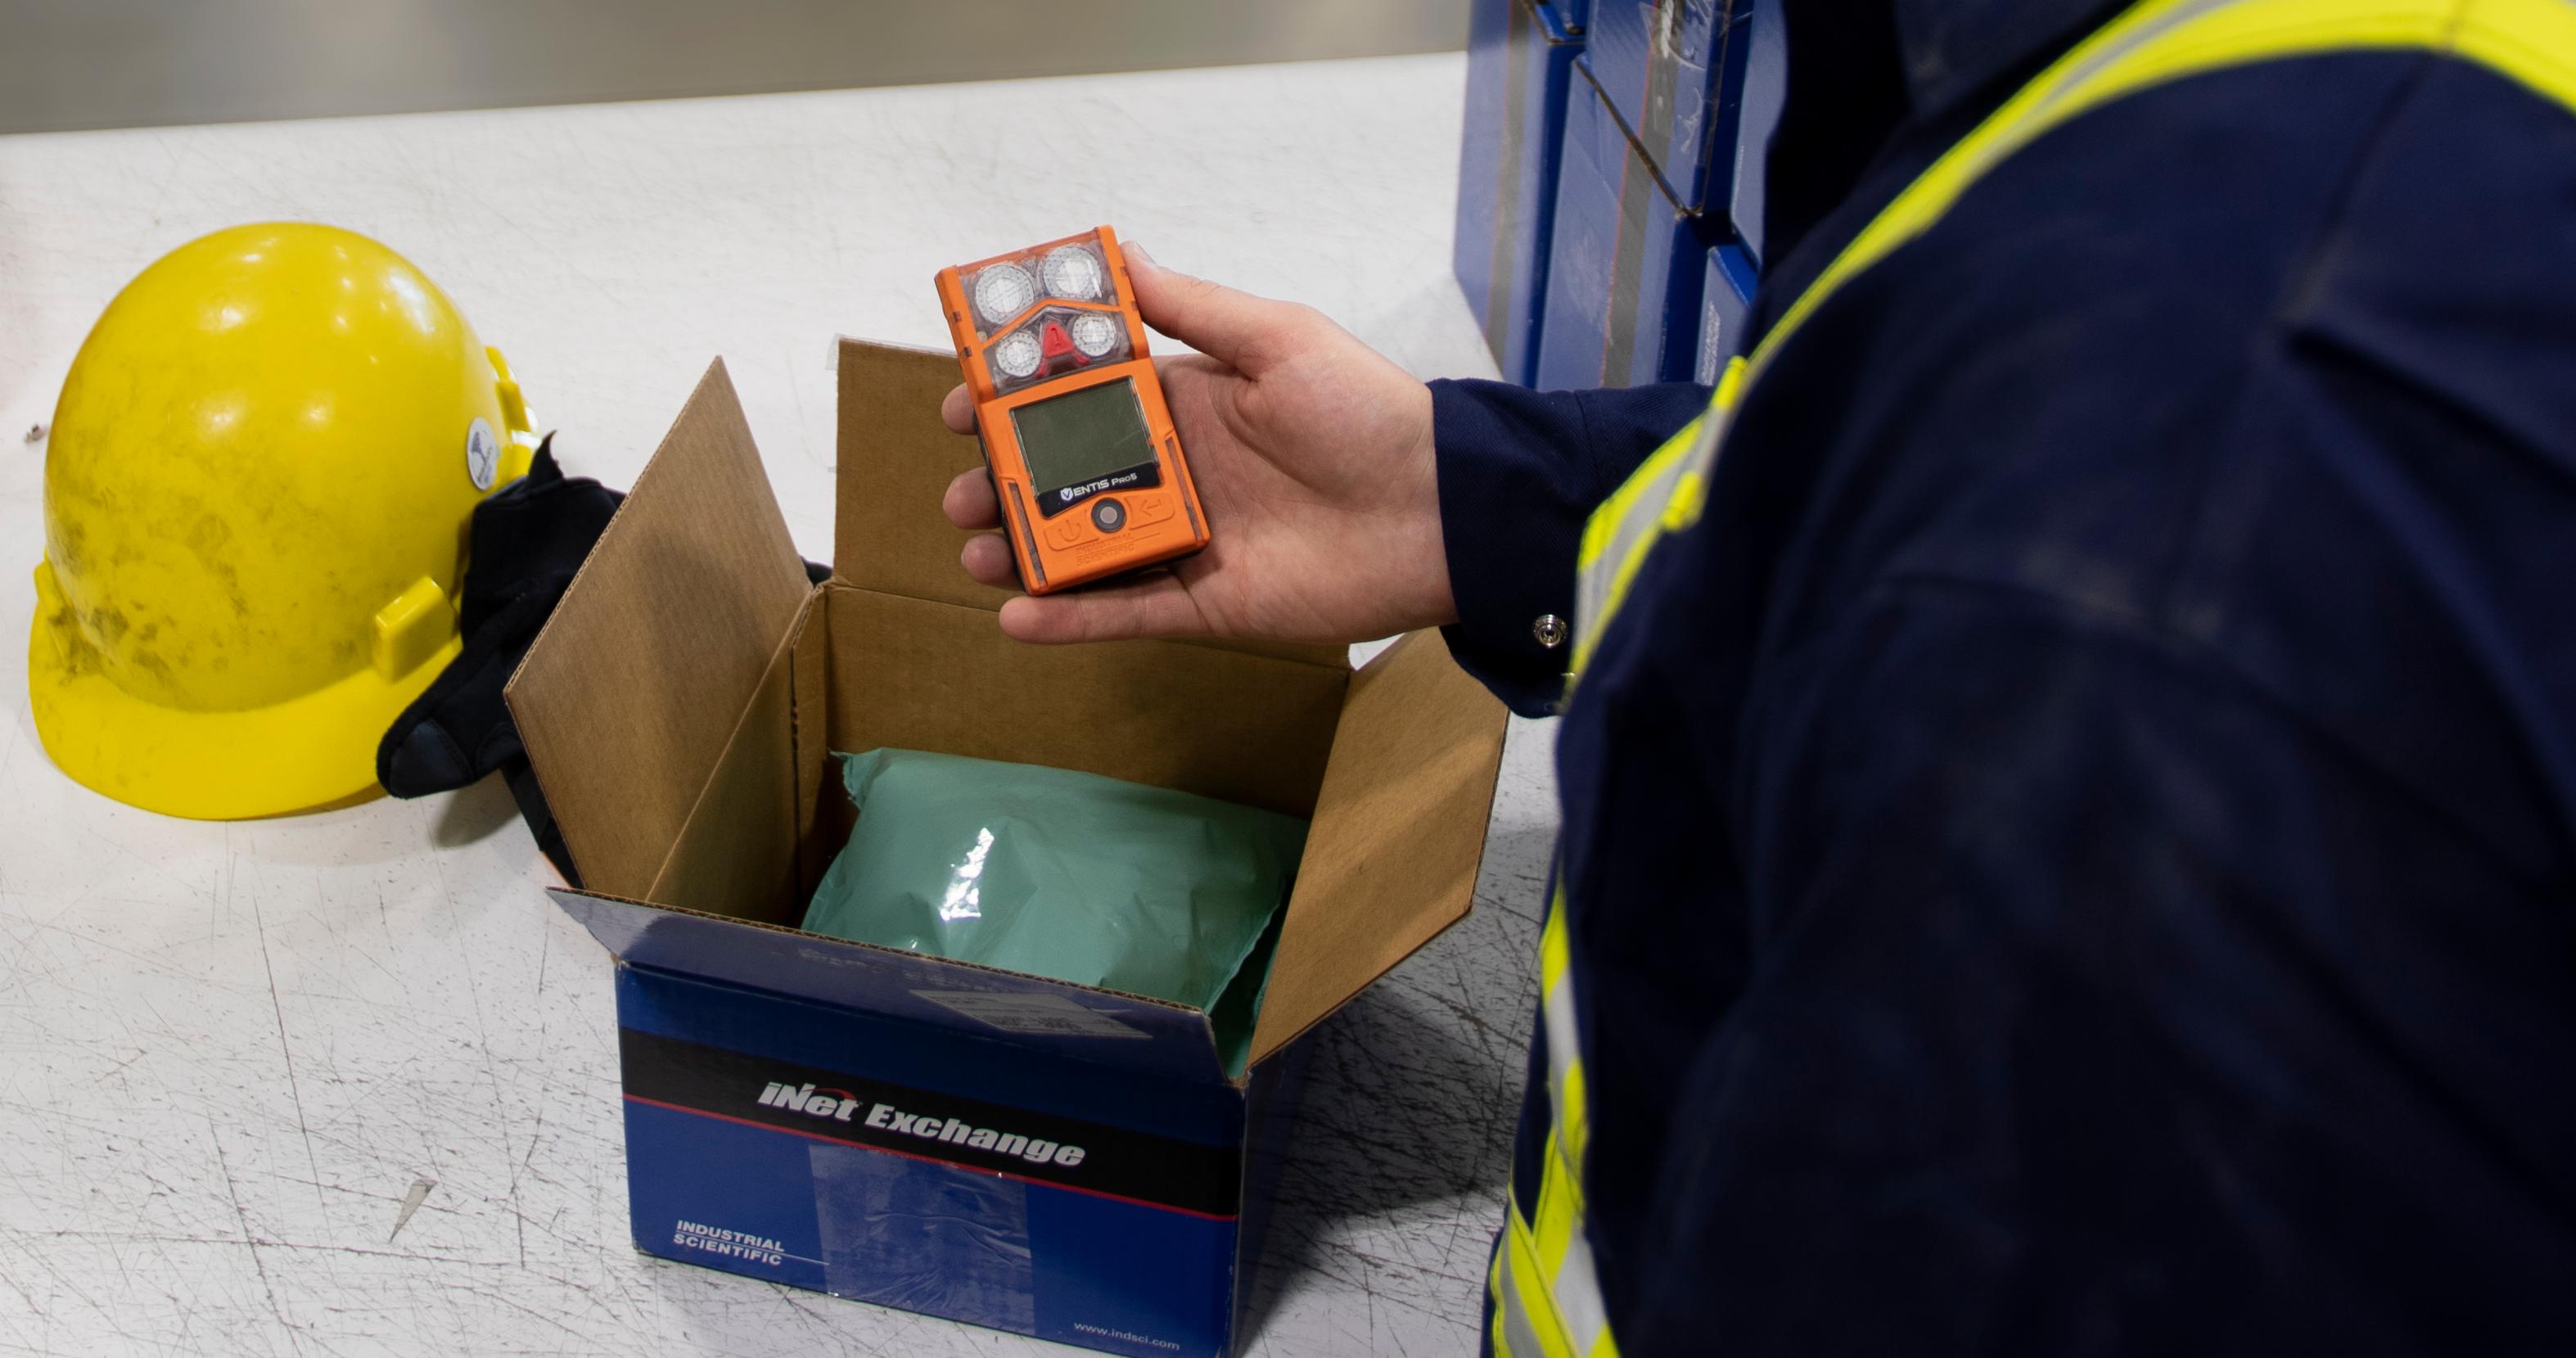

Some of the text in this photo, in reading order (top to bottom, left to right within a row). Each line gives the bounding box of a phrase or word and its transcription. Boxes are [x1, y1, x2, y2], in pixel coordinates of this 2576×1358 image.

[1060, 479, 1110, 500] VENTIS
[757, 1081, 1086, 1166] iNet Exchange
[673, 1234, 783, 1266] SCIENTIFIC
[675, 1220, 785, 1252] INDUSTRIAL
[1073, 1322, 1180, 1351] www.indsci.com
